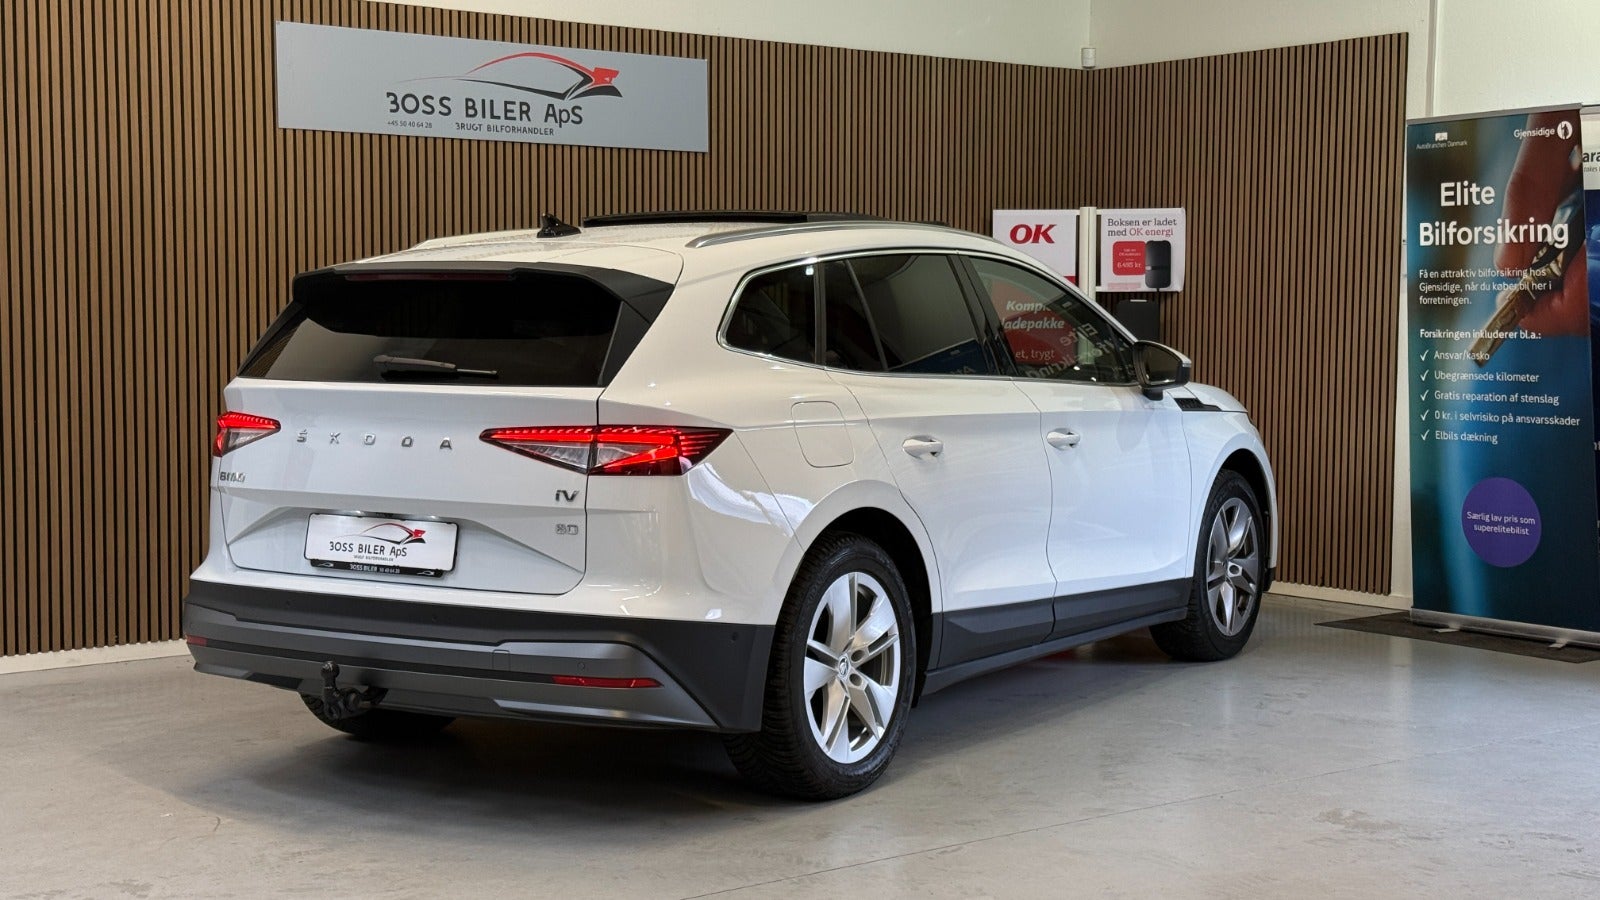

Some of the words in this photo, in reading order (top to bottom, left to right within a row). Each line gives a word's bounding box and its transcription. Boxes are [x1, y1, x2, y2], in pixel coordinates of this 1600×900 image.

[465, 97, 531, 122] BILER
[544, 103, 583, 128] ApS
[487, 124, 554, 136] BILFORHANDLER
[1514, 128, 1556, 139] Gjensidige
[1440, 180, 1496, 207] Elite
[1107, 218, 1140, 227] Boksen
[1154, 218, 1177, 226] ladet
[1009, 224, 1057, 245] OK
[1108, 228, 1127, 237] med
[1129, 228, 1144, 236] OK
[1145, 228, 1174, 238] energi
[1419, 216, 1569, 249] Bilforsikring
[1419, 268, 1428, 278] Få
[1440, 269, 1476, 278] attraktiv
[1478, 268, 1528, 280] bilforsikring
[1530, 268, 1546, 278] hos
[1419, 282, 1463, 293] Gjensidige,
[1465, 281, 1479, 291] når
[1480, 282, 1490, 291] du
[1492, 282, 1518, 291] køber
[1531, 282, 1546, 290] her
[1419, 296, 1472, 306] forretningen.
[1006, 301, 1051, 314] Komp
[1420, 329, 1471, 340] Forsikringen
[1472, 329, 1518, 340] inkluderer
[1031, 349, 1055, 360] trygt
[1434, 350, 1490, 361] Ansvar/kasko
[1434, 370, 1494, 382] Ubegrænsede
[1496, 372, 1540, 382] kilometer
[1434, 390, 1461, 401] Gratis
[1462, 392, 1507, 403] reparation
[1509, 392, 1519, 402] af
[1520, 393, 1560, 406] stenslag
[1434, 410, 1440, 420] 0
[1442, 410, 1454, 420] kr.
[1459, 412, 1500, 422] selvrisiko
[1502, 412, 1514, 424] på
[1516, 414, 1580, 426] ansvarsskader
[1435, 431, 1458, 440] Elbils
[1461, 432, 1498, 444] dækning
[1467, 512, 1490, 522] Særlig
[1491, 513, 1502, 522] lav
[1504, 514, 1518, 524] pris
[1520, 516, 1536, 525] som
[1474, 523, 1530, 536] superelitebilist
[358, 544, 385, 556] BILER
[390, 546, 408, 558] ApS
